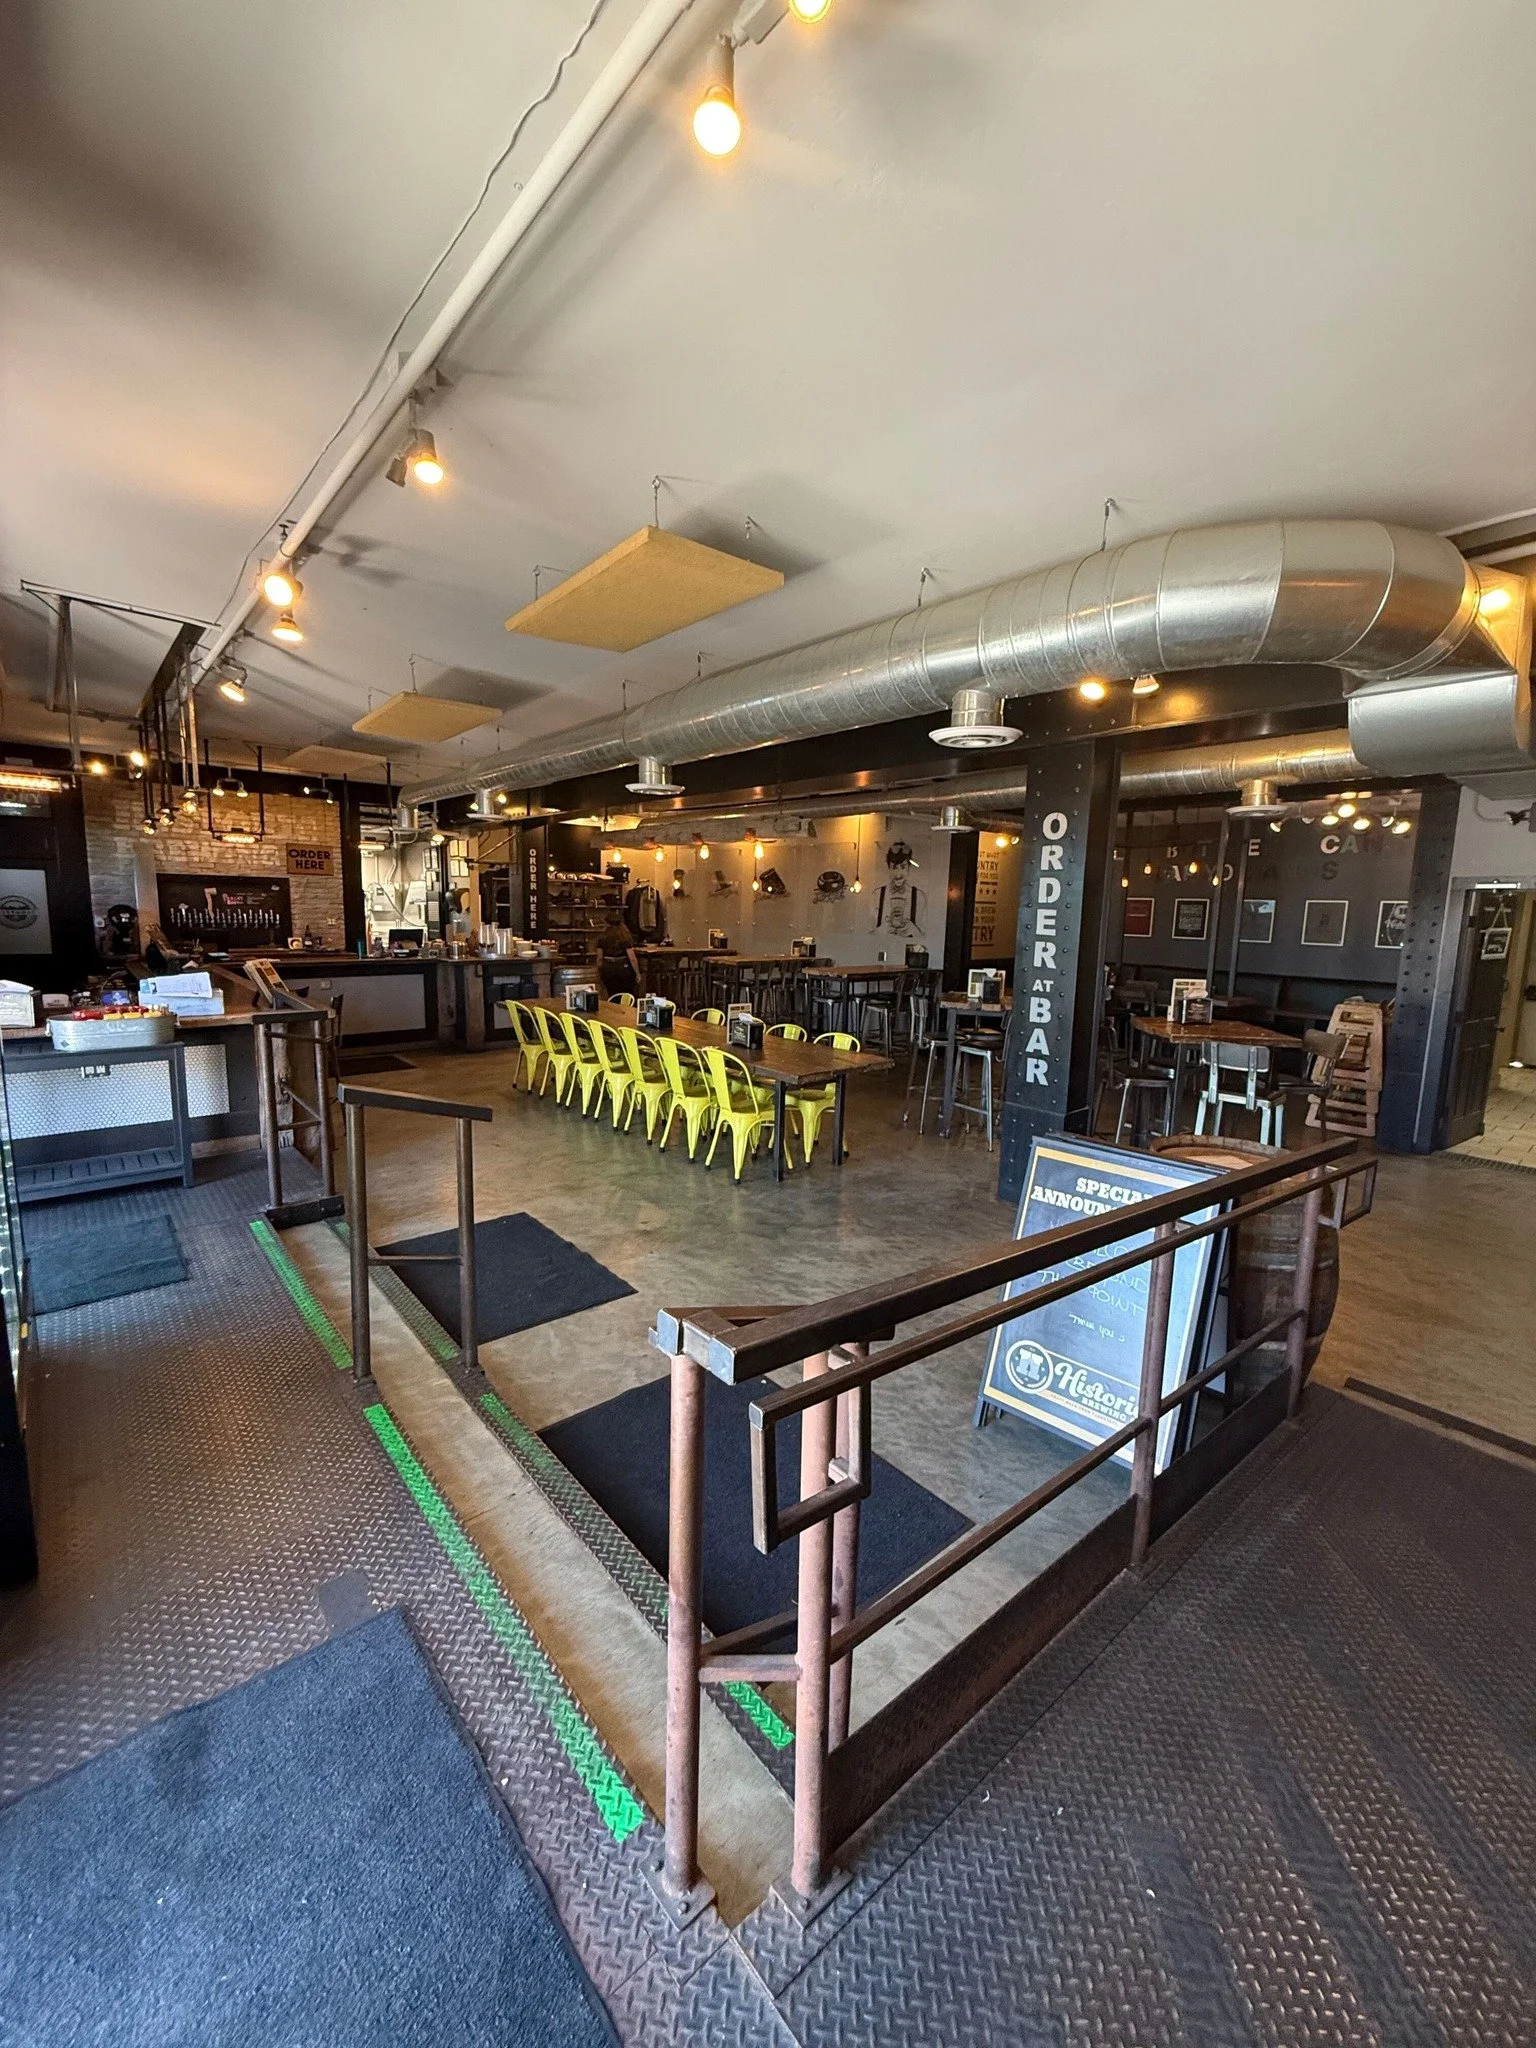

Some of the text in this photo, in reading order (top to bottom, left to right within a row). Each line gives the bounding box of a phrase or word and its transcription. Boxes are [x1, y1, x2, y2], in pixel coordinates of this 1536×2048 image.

[289, 849, 331, 860] ORDER
[296, 859, 325, 870] HERE
[980, 861, 999, 871] NTRY
[529, 848, 537, 890] ORDER
[973, 926, 995, 941] TRY
[1025, 812, 1068, 1087] ORDER AT BAR
[1030, 1185, 1117, 1217] ANNOUN
[1054, 1362, 1139, 1417] Histori
